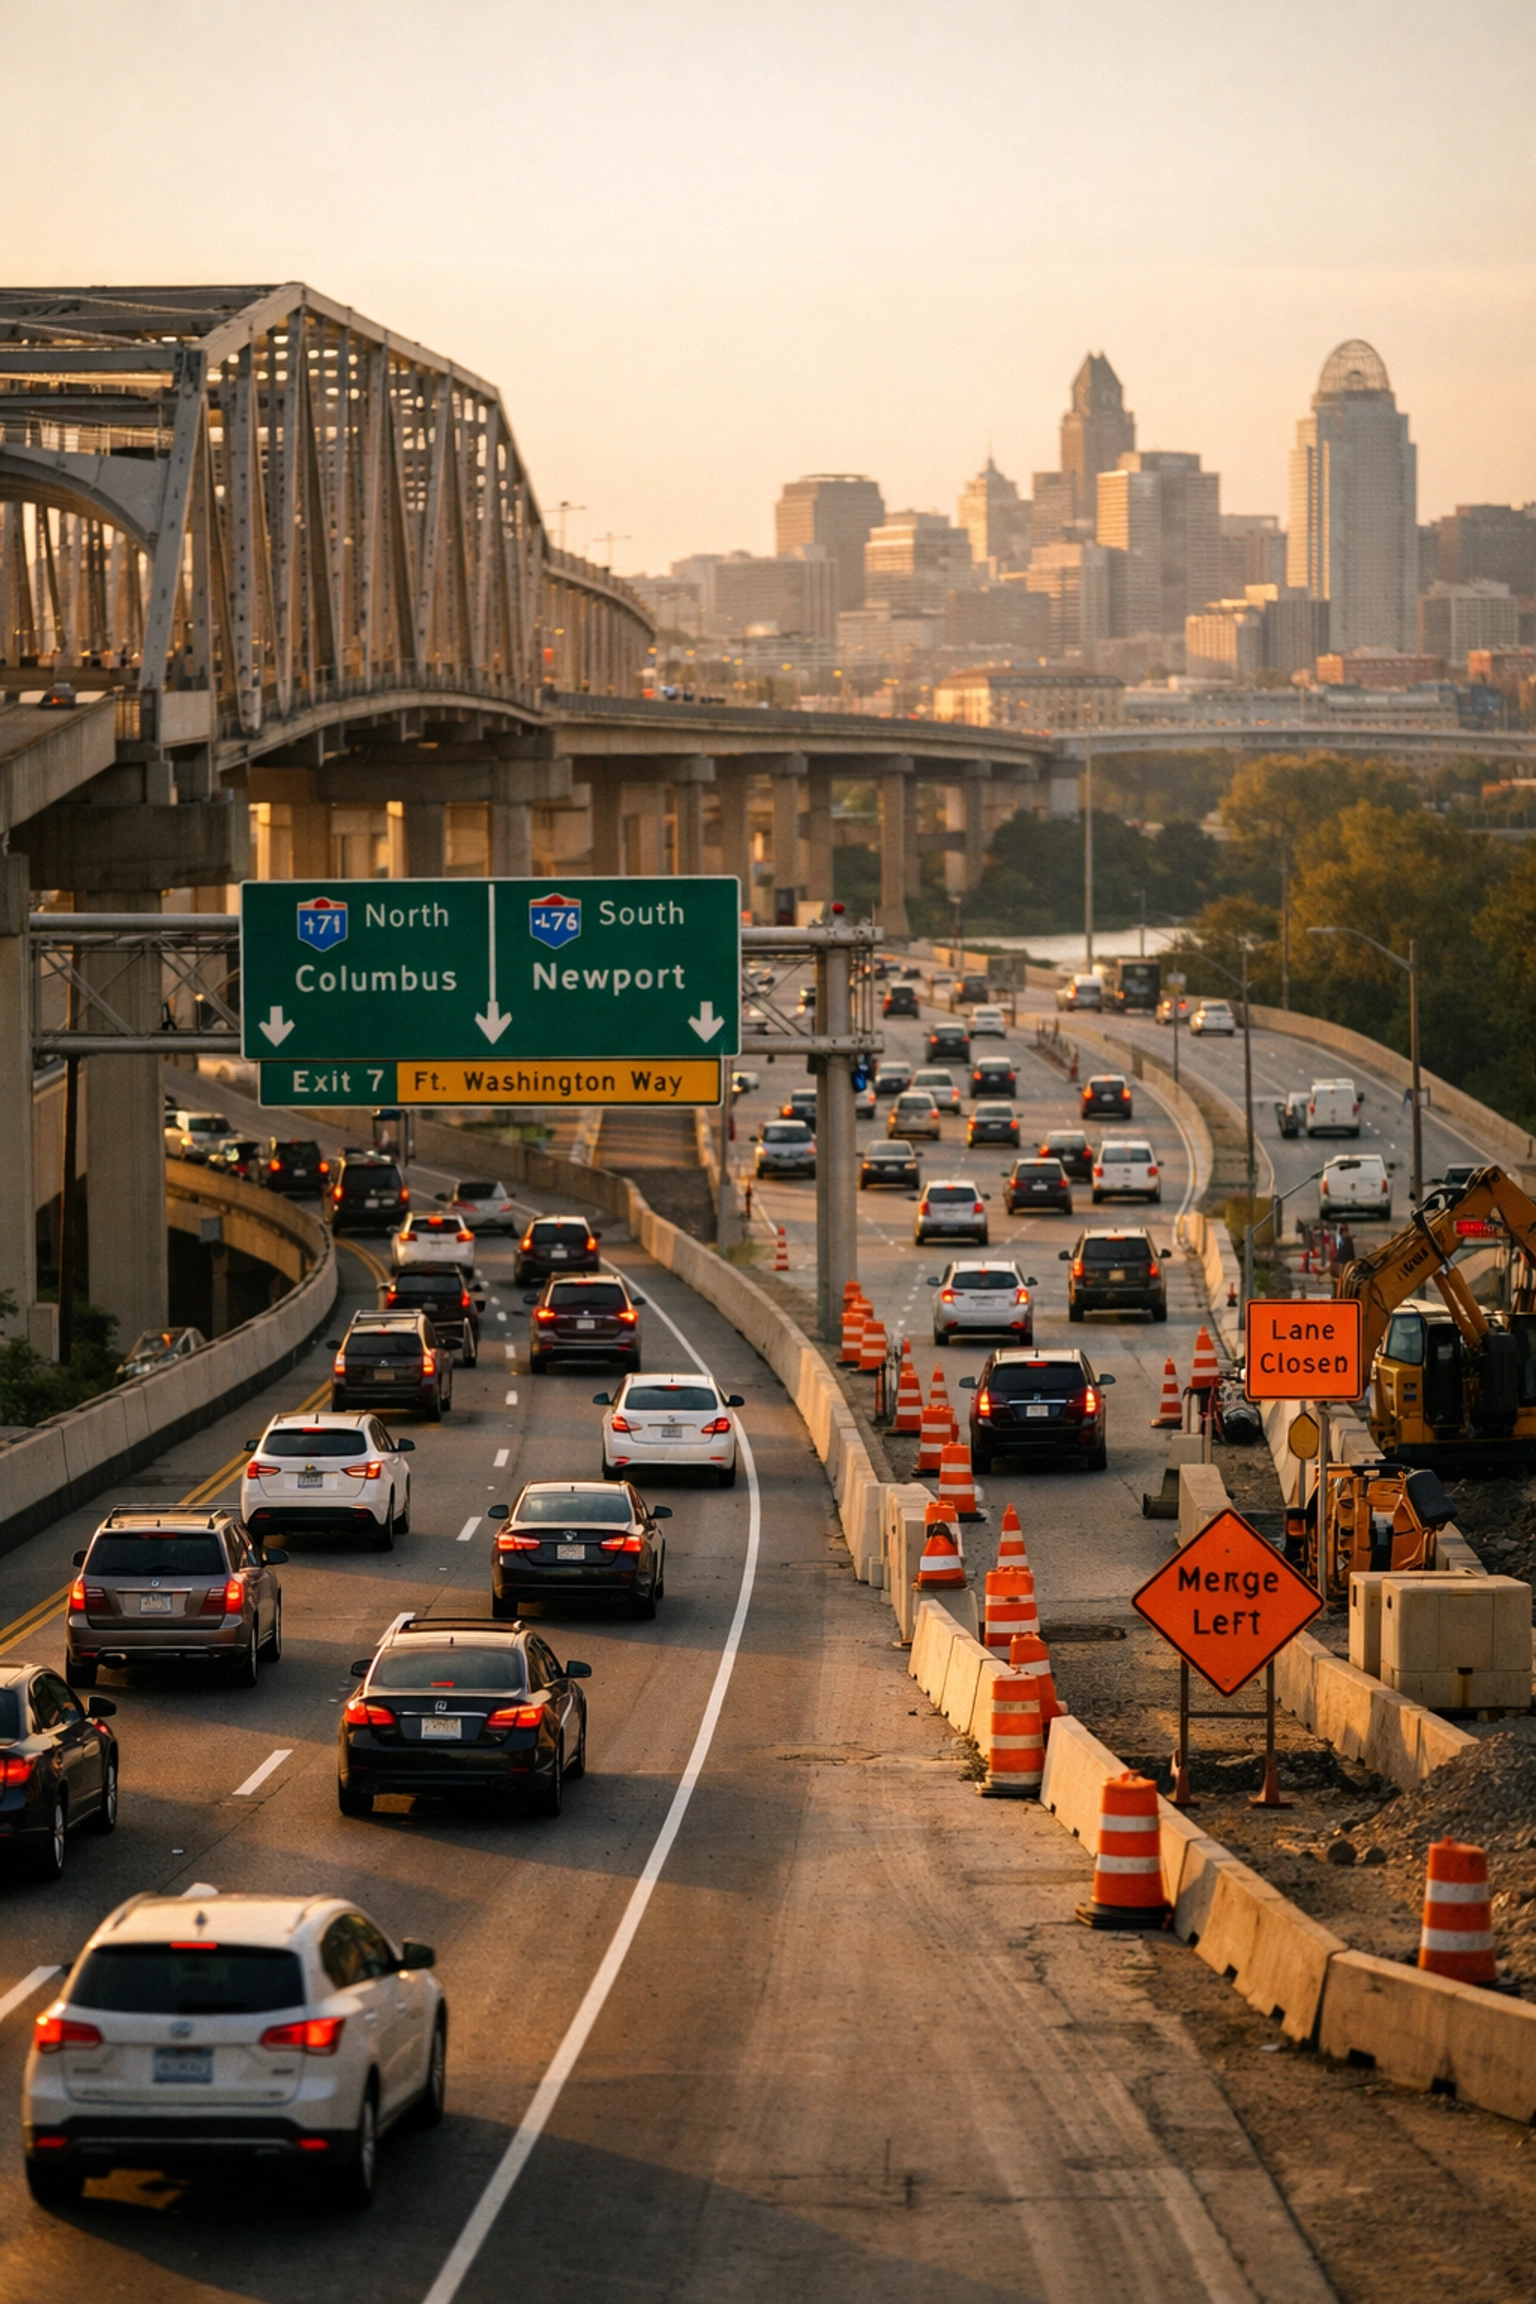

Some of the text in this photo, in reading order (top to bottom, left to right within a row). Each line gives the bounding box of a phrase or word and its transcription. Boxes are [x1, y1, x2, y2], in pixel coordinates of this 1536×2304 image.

[365, 902, 449, 928] North
[599, 900, 684, 926] South
[295, 964, 457, 993] Columbus
[533, 962, 685, 997] Newport
[292, 1069, 384, 1093] Exit 7
[414, 1070, 683, 1097] Ft. Washington Way
[1272, 1319, 1335, 1340] Lane
